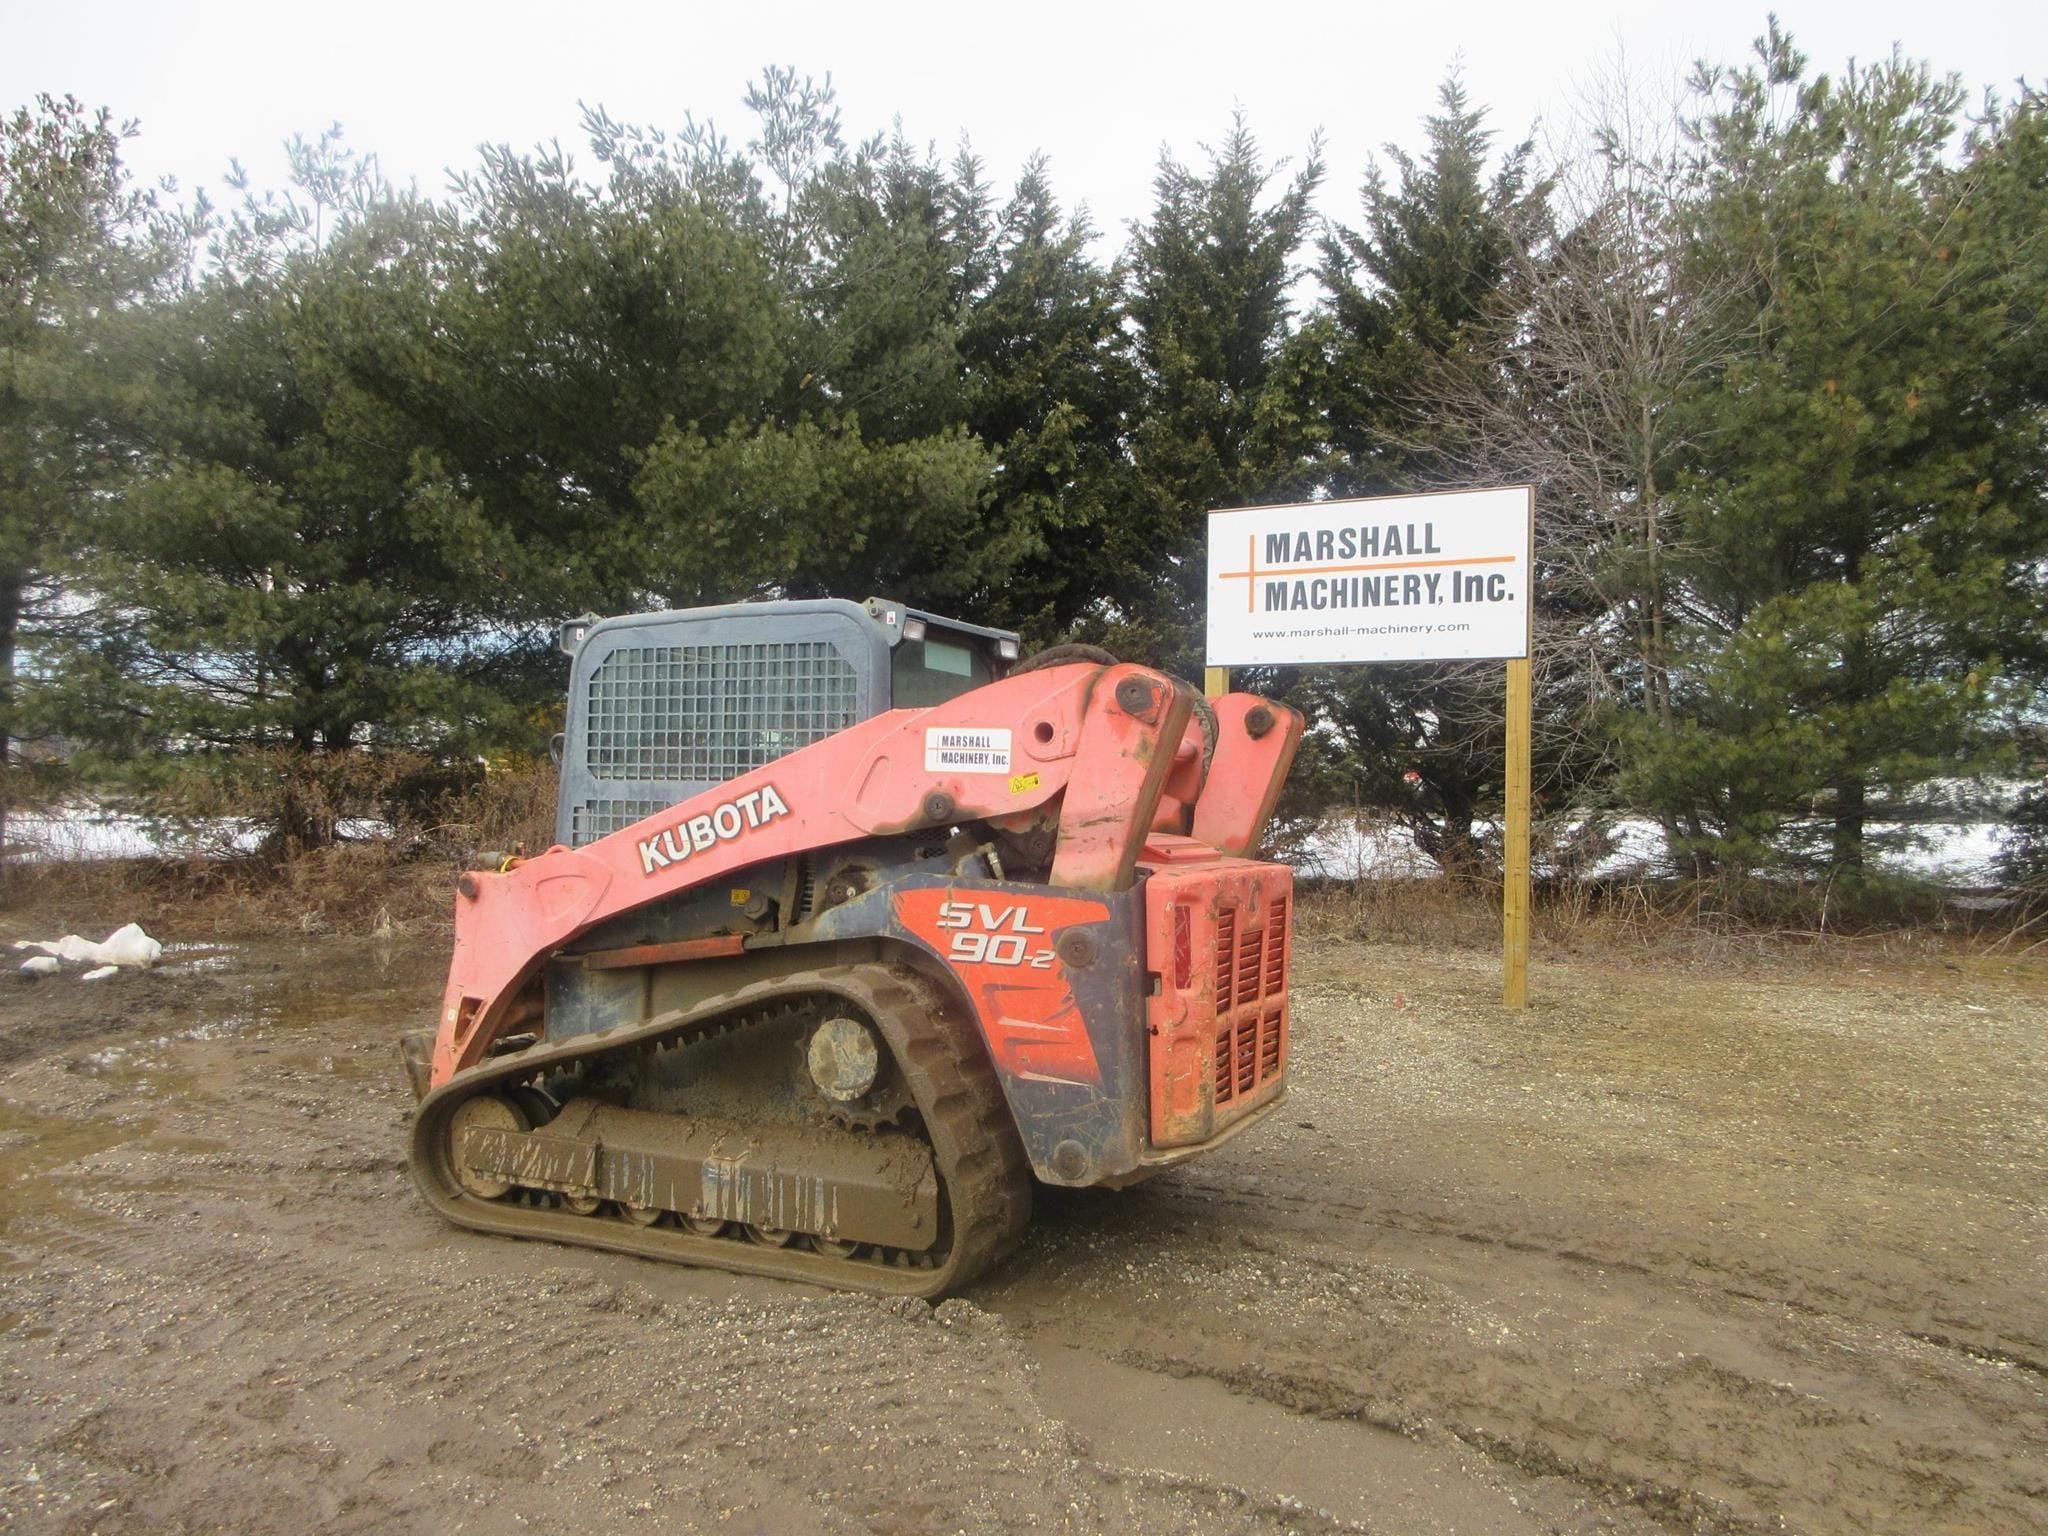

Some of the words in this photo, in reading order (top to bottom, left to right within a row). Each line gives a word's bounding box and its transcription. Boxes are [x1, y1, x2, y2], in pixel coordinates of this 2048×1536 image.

[1265, 522, 1441, 564] MARSHALL
[1264, 573, 1444, 612] MACHINERY,
[1452, 570, 1515, 604] Inc.
[1252, 621, 1471, 639] www.marshall-machinery.com
[941, 735, 991, 748] MARSHALL
[992, 753, 1009, 766] Inc.
[637, 784, 789, 874] KUBOTA
[936, 902, 1045, 934] SVL
[948, 932, 1057, 969] 90-2
